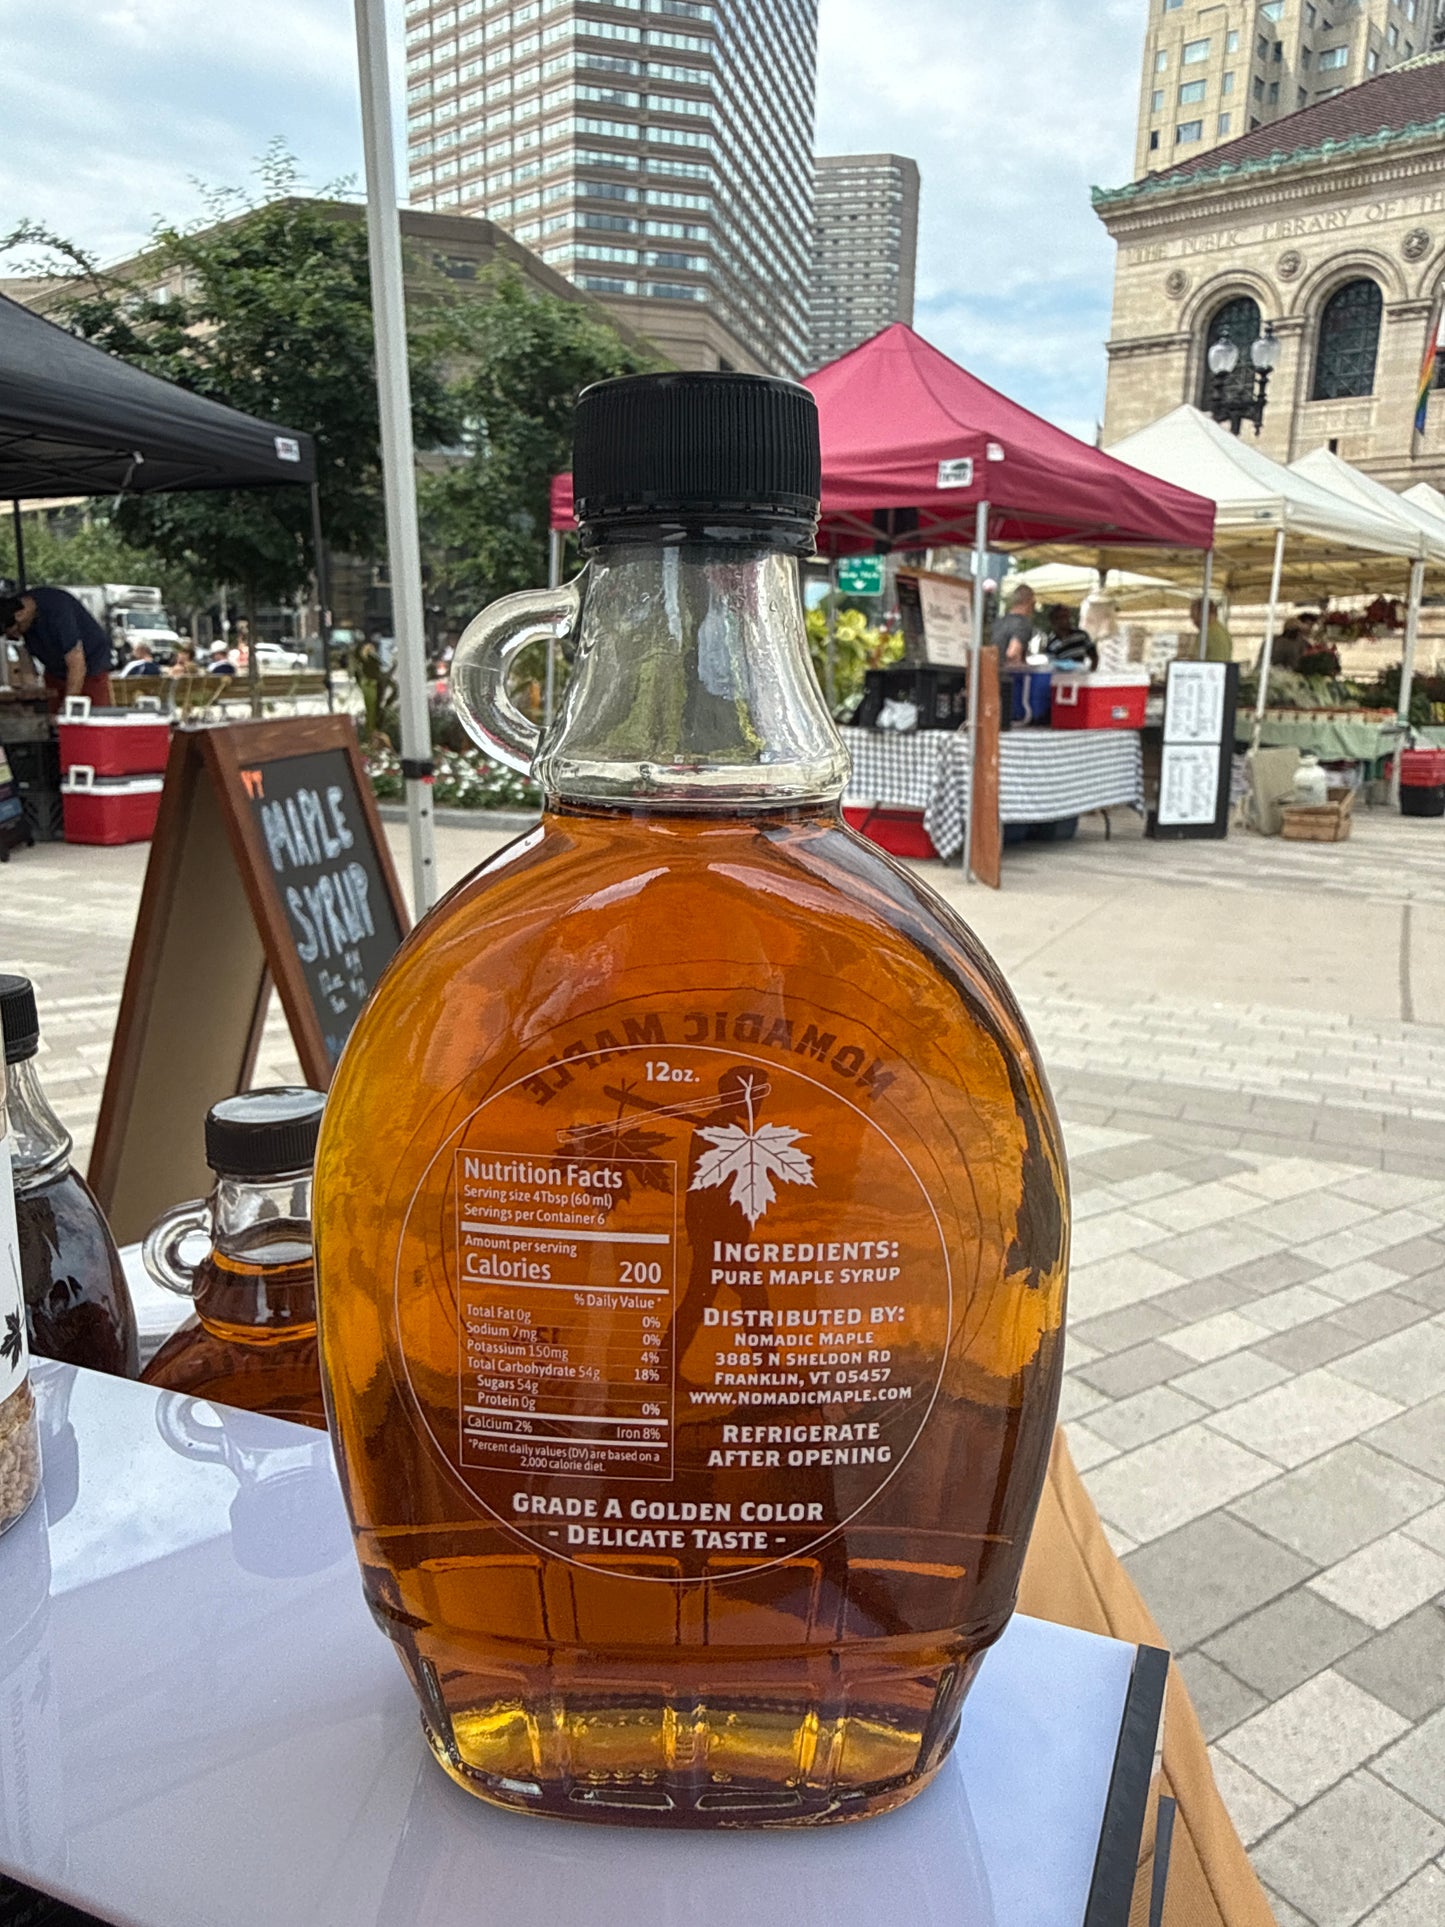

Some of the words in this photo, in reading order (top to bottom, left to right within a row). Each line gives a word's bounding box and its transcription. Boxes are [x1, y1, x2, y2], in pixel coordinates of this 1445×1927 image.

[1131, 243, 1167, 263] THE
[1182, 228, 1244, 254] PUBLIC
[1262, 209, 1351, 239] LIBRARY
[1366, 201, 1399, 222] OF
[262, 786, 354, 873] MAPLE
[286, 862, 375, 963] SYRUP
[464, 1157, 561, 1186] Nutrition
[566, 1164, 623, 1188] Facts
[464, 1185, 507, 1203] Serving
[509, 1189, 531, 1202] size
[464, 1204, 512, 1222] Servings
[515, 1210, 535, 1223] per
[536, 1209, 595, 1225] Container
[597, 1212, 606, 1225] 6
[464, 1234, 511, 1250] Amount
[513, 1240, 532, 1253] per
[534, 1242, 578, 1258] serving
[713, 1240, 899, 1263] INGREDIENTS:
[465, 1253, 552, 1281] Calories
[619, 1261, 662, 1284] 200
[711, 1269, 763, 1285] PURE
[769, 1269, 834, 1285] MAPLE
[840, 1267, 900, 1283] SYRUP
[574, 1293, 585, 1305] %
[586, 1293, 617, 1310] Daily
[467, 1303, 495, 1319] Total
[497, 1306, 514, 1320] Fat
[516, 1308, 532, 1325] 0g
[642, 1316, 661, 1329] 0%
[703, 1307, 861, 1327] DISTRIBUTED
[870, 1306, 905, 1324] BY:
[466, 1321, 509, 1337] Sodium
[512, 1325, 538, 1342] 7mg
[642, 1333, 661, 1346] 0%
[734, 1332, 813, 1347] NOMADIC
[819, 1331, 874, 1345] MAPLE
[467, 1339, 526, 1357] Potassium
[528, 1344, 569, 1362] 150mg
[640, 1351, 660, 1364] 4%
[715, 1352, 763, 1366] 3885
[768, 1352, 780, 1366] N
[786, 1351, 862, 1366] SHELDON
[868, 1350, 891, 1363] RD
[467, 1356, 496, 1371] Total
[497, 1359, 576, 1379] Carbohydrate
[578, 1366, 601, 1382] 54g
[634, 1368, 660, 1382] 18%
[714, 1371, 805, 1387] FRANKLIN,
[809, 1371, 831, 1385] VT
[835, 1368, 892, 1384] 05457
[477, 1374, 515, 1391] Sugars
[517, 1378, 539, 1395] 54g
[477, 1391, 519, 1408] Protein
[521, 1395, 536, 1411] 0g
[642, 1403, 661, 1416] 0%
[467, 1414, 513, 1432] Calcium
[515, 1419, 533, 1433] 2%
[616, 1426, 640, 1440] Iron
[643, 1427, 661, 1440] 8%
[722, 1422, 880, 1443] REFRIGERATE
[509, 1442, 533, 1457] daily
[534, 1446, 567, 1459] values
[568, 1446, 588, 1460] (DV)
[589, 1450, 606, 1461] are
[608, 1449, 637, 1462] based
[639, 1452, 652, 1462] on
[653, 1453, 660, 1462] a
[707, 1450, 780, 1467] AFTER
[788, 1446, 891, 1466] OPENING
[520, 1456, 547, 1470] 2,000
[549, 1458, 582, 1471] calorie
[584, 1460, 606, 1472] diet.
[512, 1492, 598, 1518] GRADE
[603, 1498, 623, 1519] A
[630, 1499, 731, 1522] GOLDEN
[740, 1501, 824, 1522] COLOR
[567, 1524, 685, 1548] DELICATE
[691, 1529, 768, 1550] TASTE
